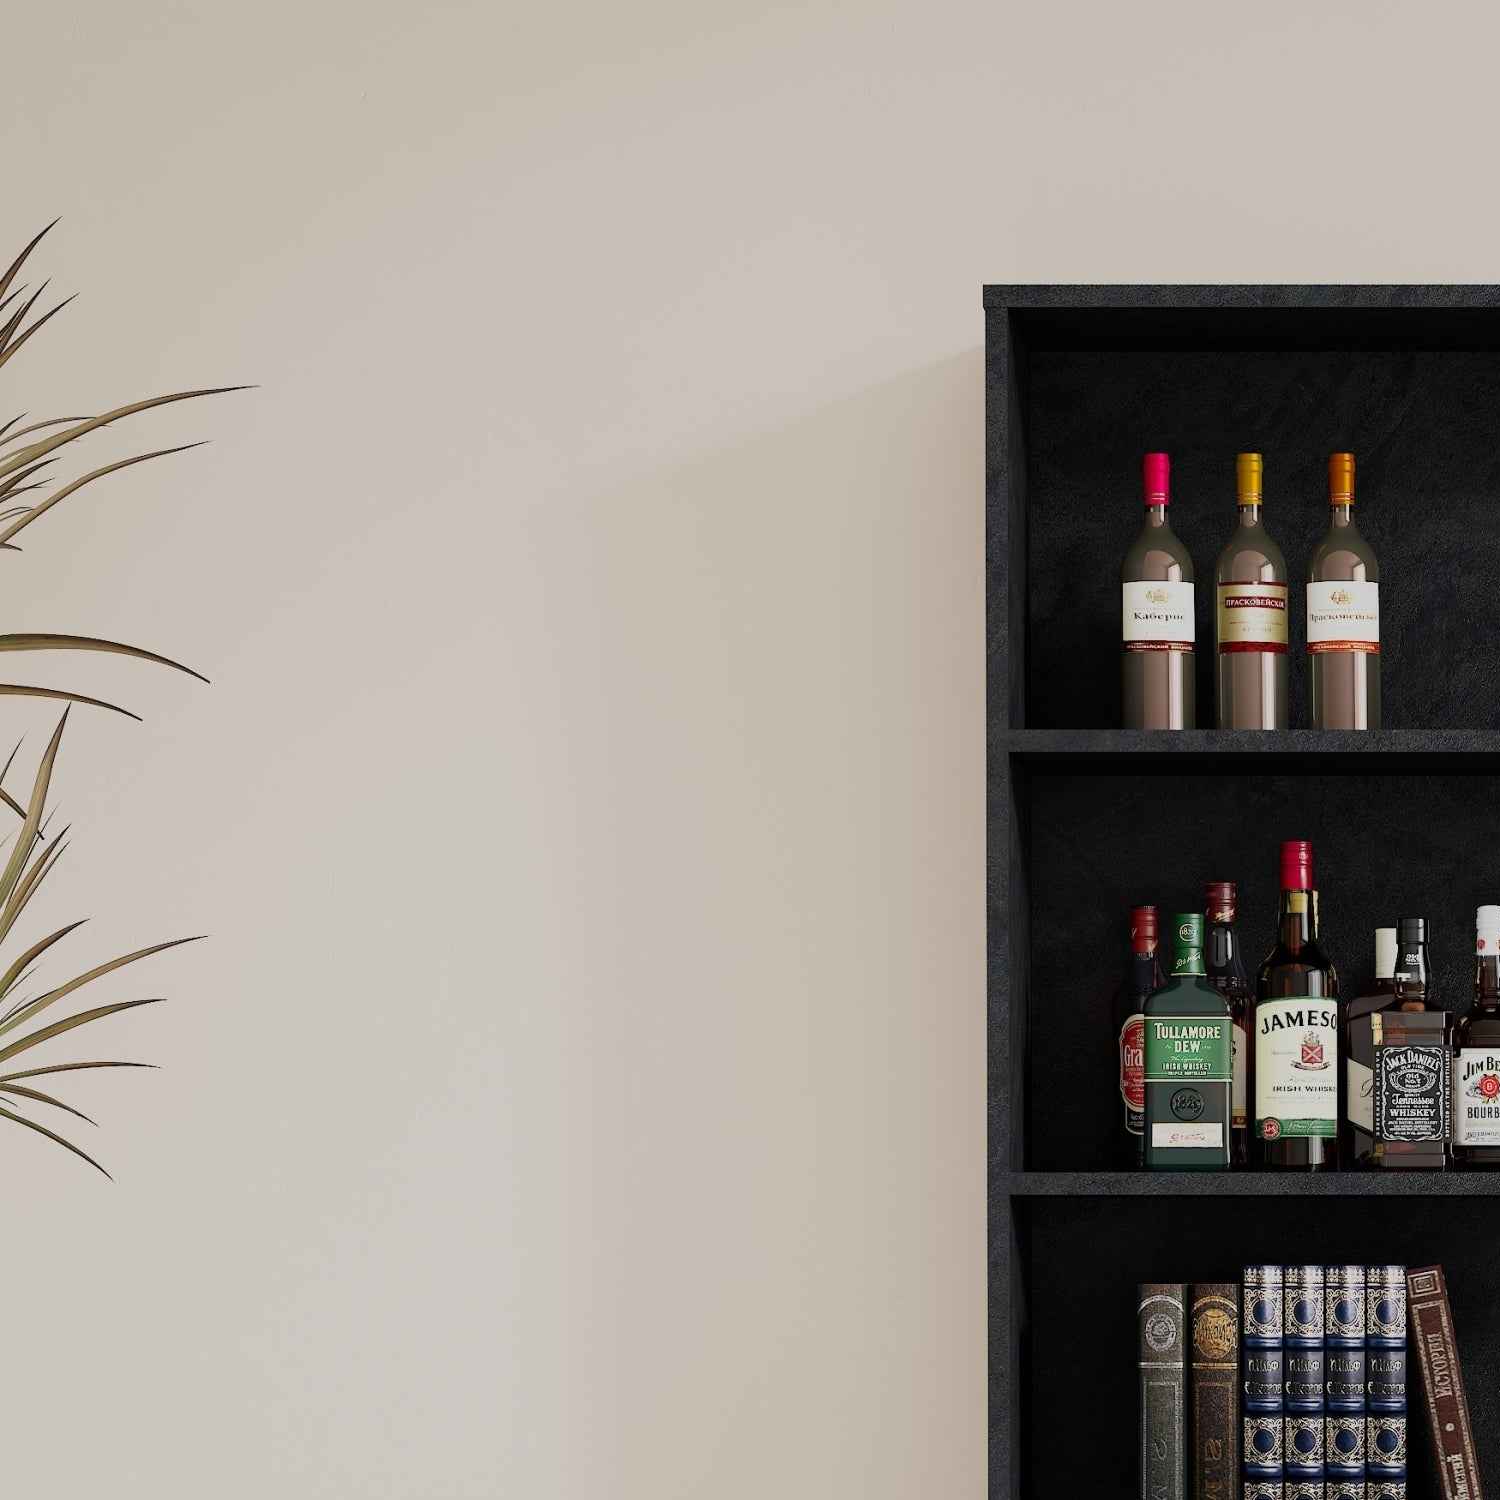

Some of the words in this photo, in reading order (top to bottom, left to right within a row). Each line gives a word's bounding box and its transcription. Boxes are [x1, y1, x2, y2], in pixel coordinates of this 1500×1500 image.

[1174, 1040, 1201, 1053] DEW
[1161, 1062, 1181, 1070] IRISH
[1182, 1062, 1212, 1070] WHISKEY
[1462, 1061, 1484, 1081] JIM
[1389, 1108, 1437, 1117] WHISKEY
